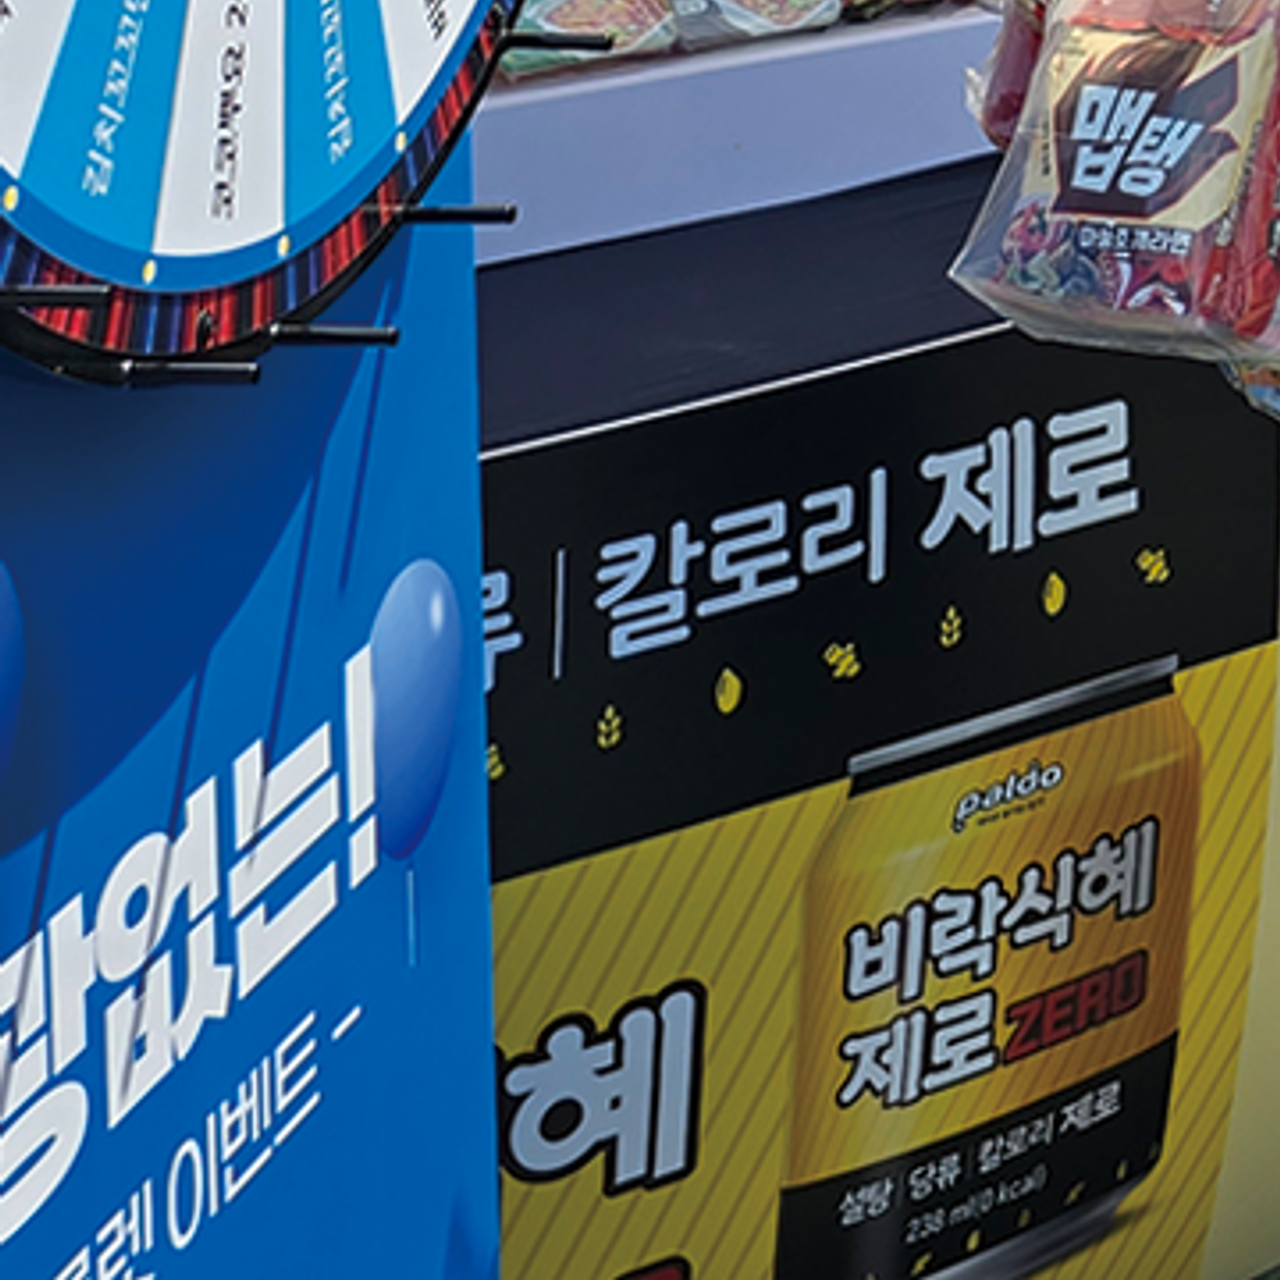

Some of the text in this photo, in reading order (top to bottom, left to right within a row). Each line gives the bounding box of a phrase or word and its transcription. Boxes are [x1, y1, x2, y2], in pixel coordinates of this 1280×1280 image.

[594, 465, 889, 661] 칼로리
[918, 399, 1141, 555] 제로
[951, 757, 1064, 834] paldo
[842, 816, 1162, 1002] 비락식혜
[836, 948, 1150, 1109] 제로 ZERO
[167, 1010, 323, 1251] 이벤트
[839, 1079, 1122, 1227] 설탕 당류 칼로리 제로
